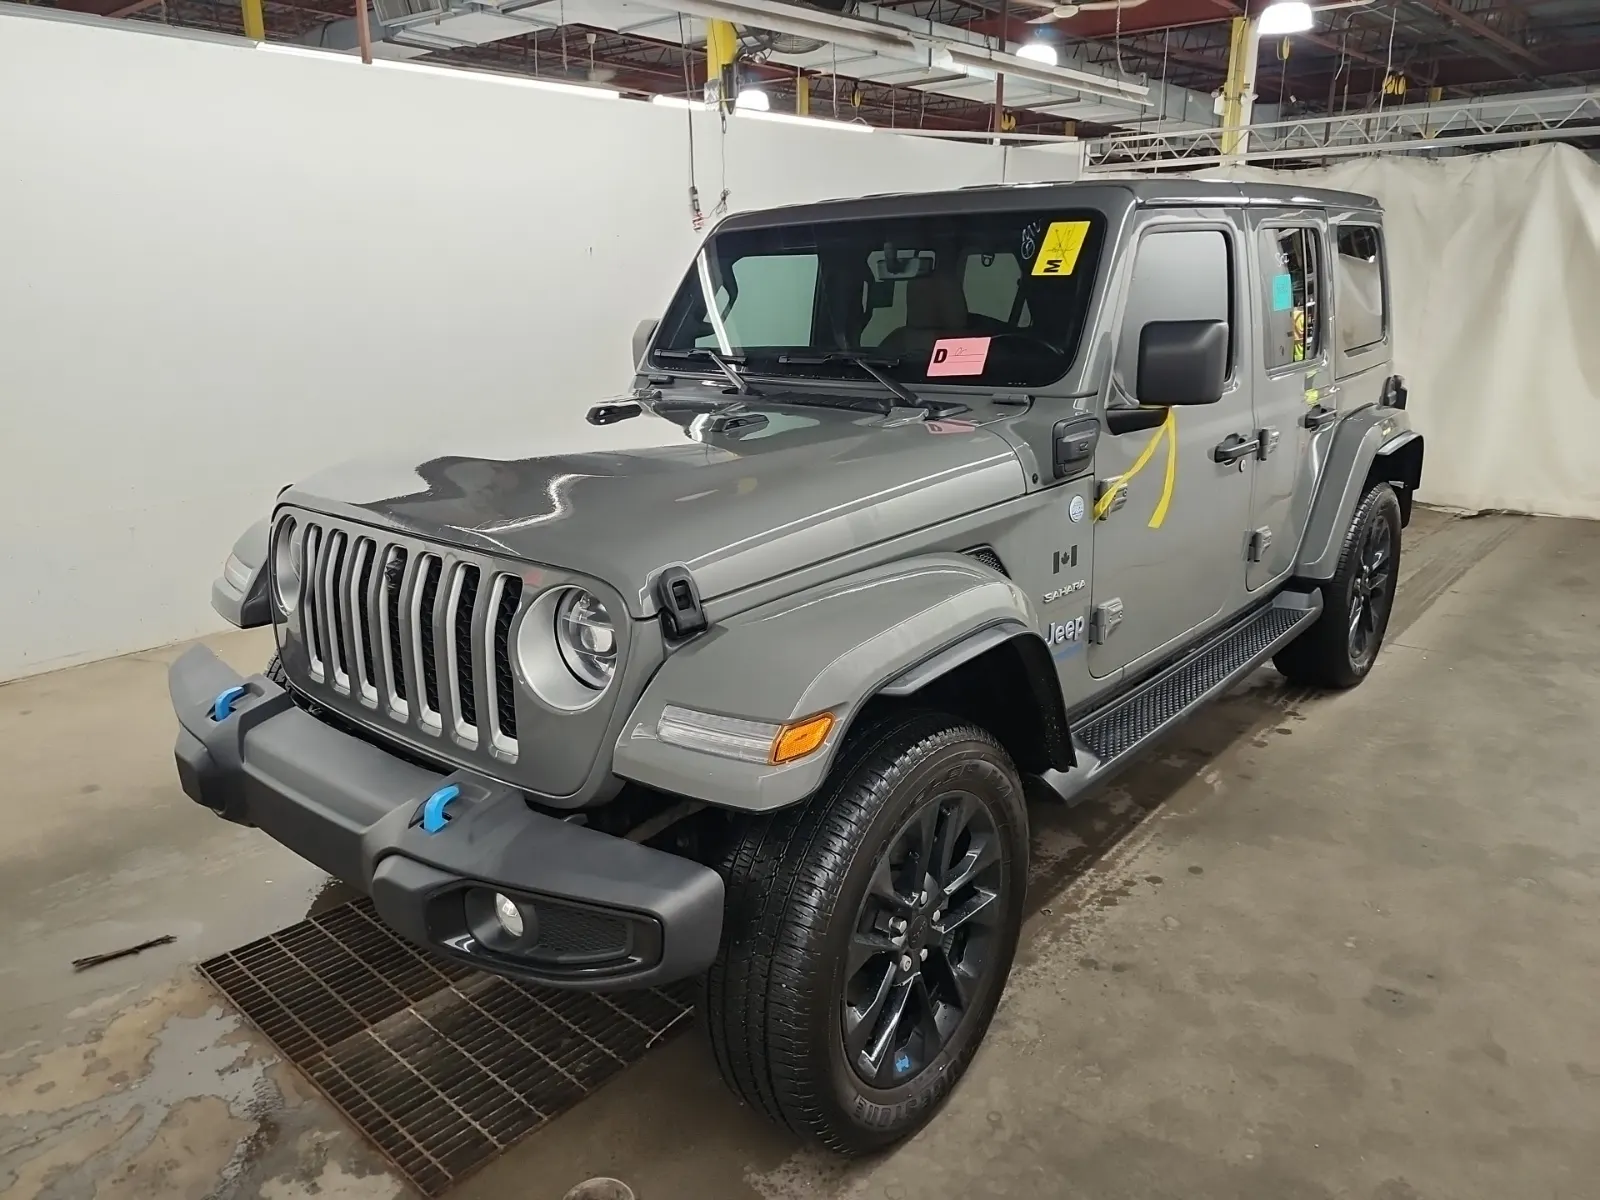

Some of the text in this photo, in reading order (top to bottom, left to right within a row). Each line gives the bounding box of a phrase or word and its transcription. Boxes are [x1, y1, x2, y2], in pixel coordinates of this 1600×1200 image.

[1043, 259, 1063, 273] M
[933, 349, 948, 363] D
[1043, 579, 1086, 604] SAHARA
[1045, 615, 1085, 646] Jeep
